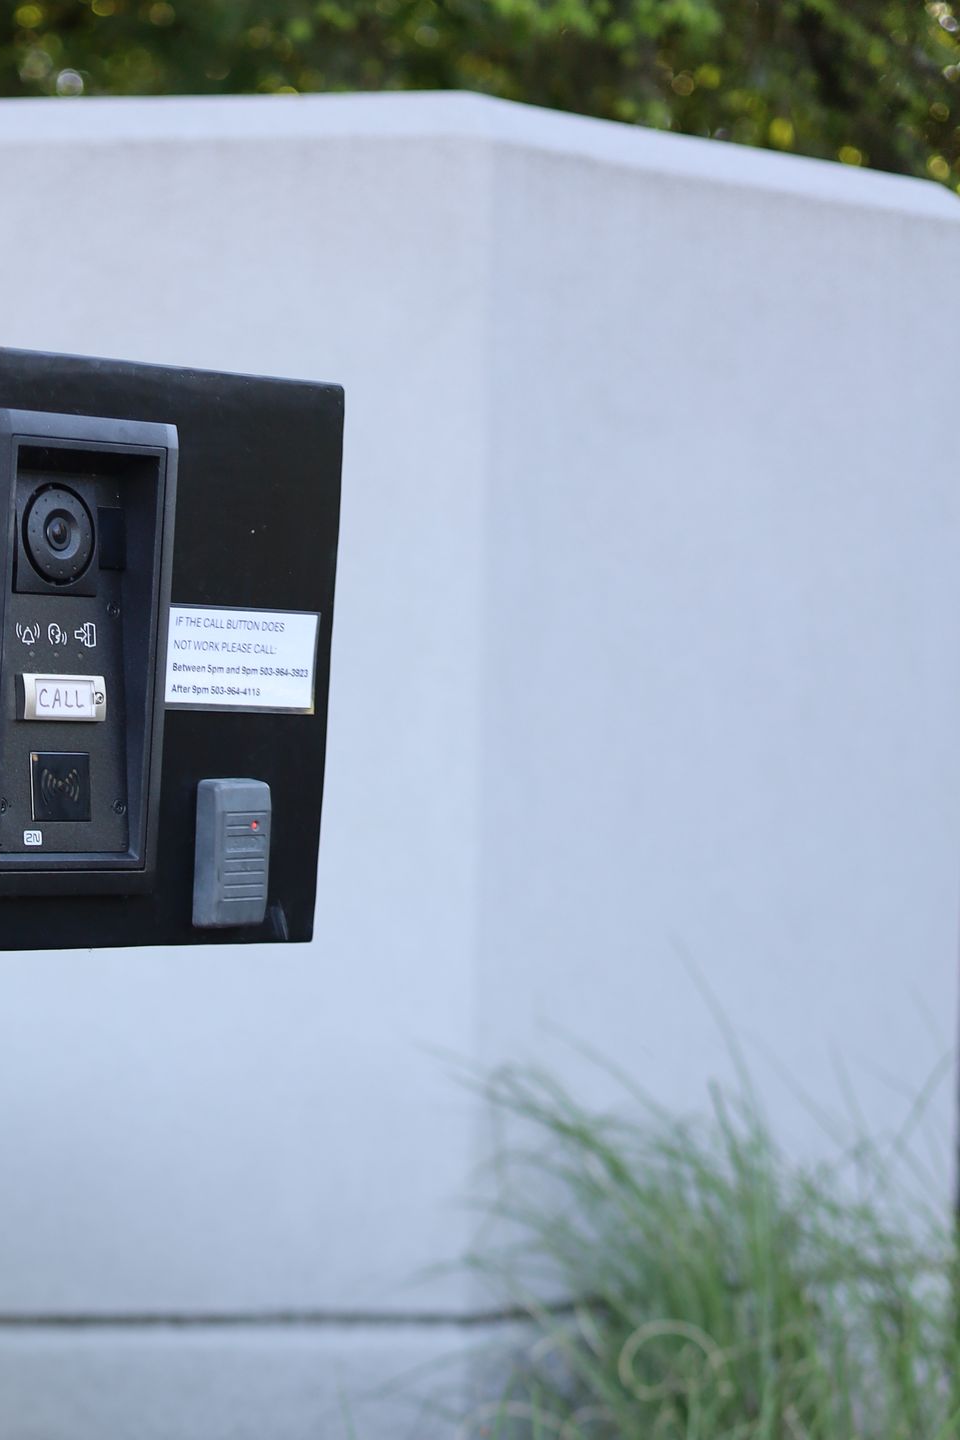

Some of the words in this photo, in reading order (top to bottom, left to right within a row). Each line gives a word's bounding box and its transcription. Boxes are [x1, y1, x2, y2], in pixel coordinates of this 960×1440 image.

[175, 616, 184, 626] IF
[185, 617, 202, 628] THE
[203, 618, 225, 629] CALL
[226, 619, 260, 631] BUTTON
[261, 621, 285, 632] DOES
[174, 640, 192, 650] NOT
[193, 641, 220, 651] WORK
[221, 642, 253, 653] PLEASE
[253, 643, 278, 655] CALL:
[172, 662, 206, 673] Between
[207, 664, 224, 675] 5pm
[226, 666, 240, 675] and
[241, 666, 258, 677] 9pm
[171, 684, 190, 694] After
[192, 685, 209, 696] 9pm
[38, 688, 85, 709] CALL
